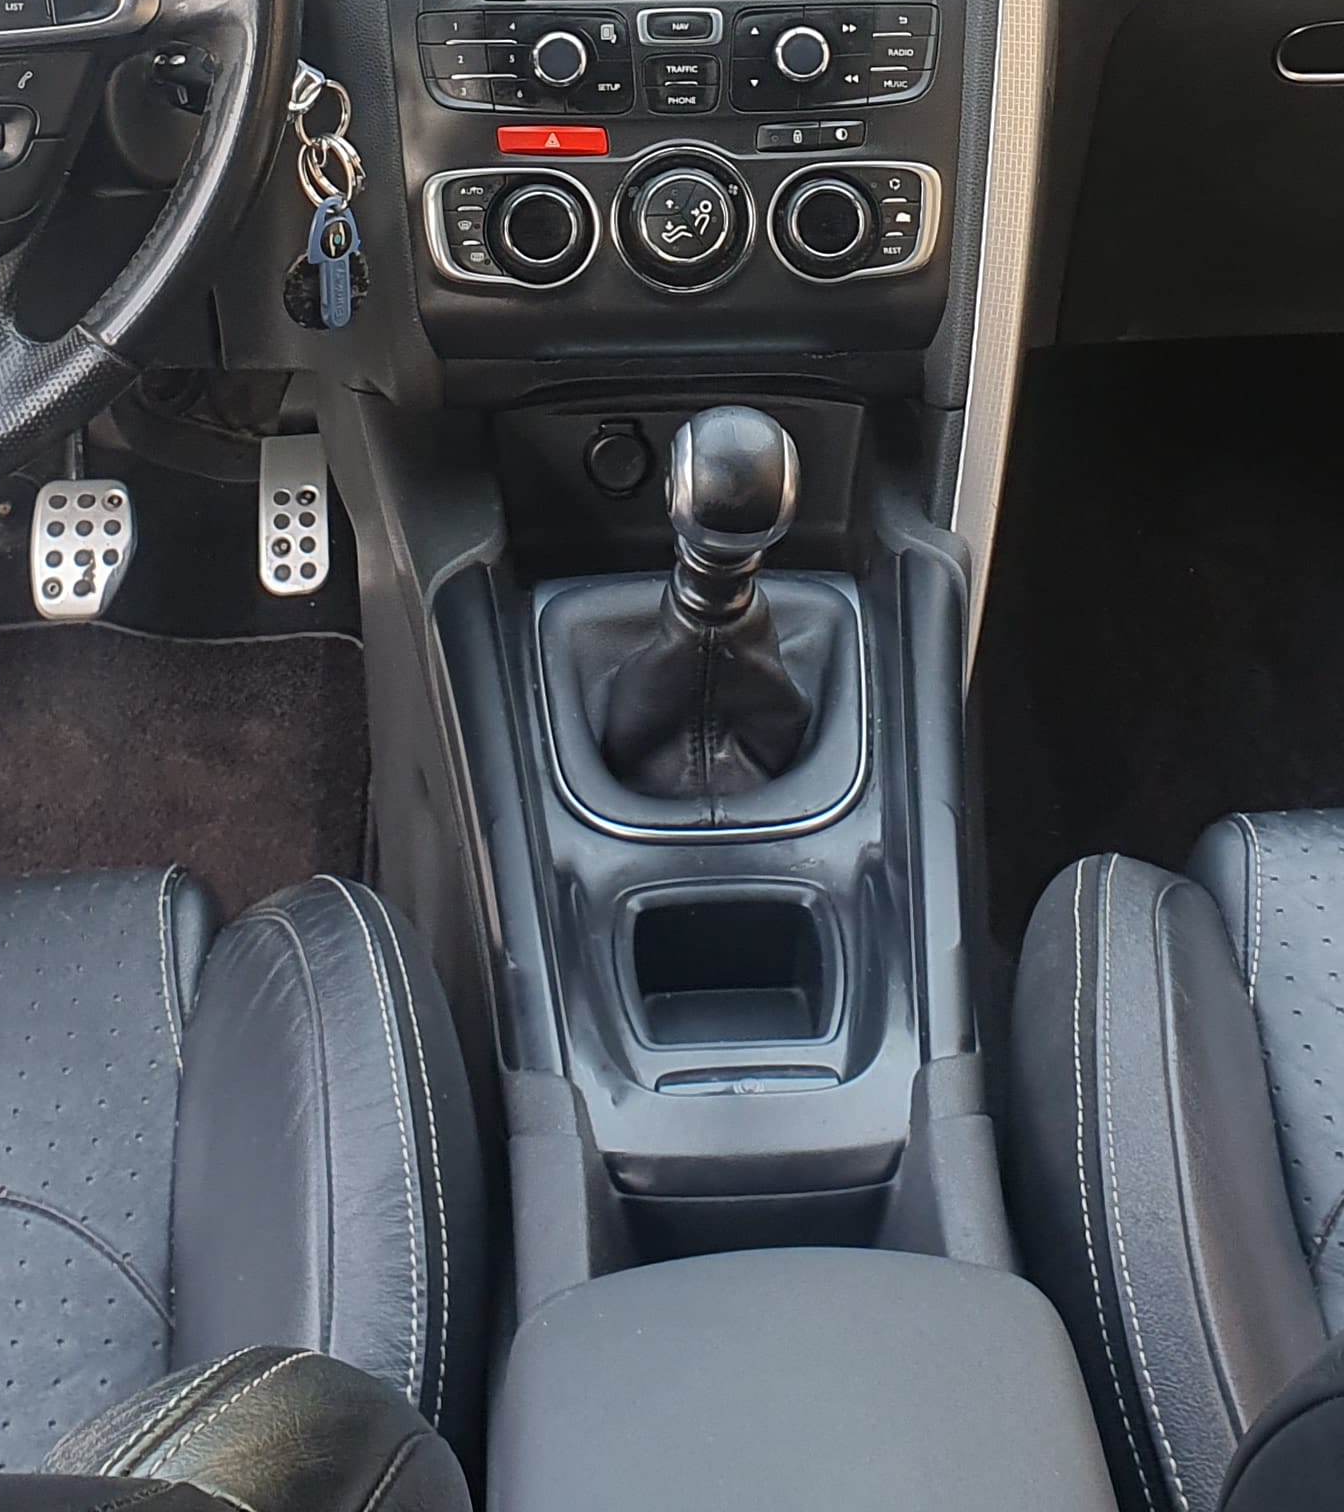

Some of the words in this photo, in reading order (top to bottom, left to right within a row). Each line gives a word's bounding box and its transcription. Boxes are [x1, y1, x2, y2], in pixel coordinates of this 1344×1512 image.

[5, 2, 25, 12] LIST
[508, 22, 516, 31] 4
[672, 22, 690, 31] NAV
[887, 48, 914, 57] RADIO
[457, 55, 465, 64] 2
[508, 55, 515, 64] 5
[666, 65, 698, 74] TRAFFIC
[597, 82, 622, 92] SETUP
[883, 79, 909, 89] MUSIC
[460, 87, 467, 96] 3
[516, 89, 524, 98] 6
[667, 96, 697, 105] PHONE
[460, 186, 484, 195] AUTO
[882, 246, 902, 255] REST
